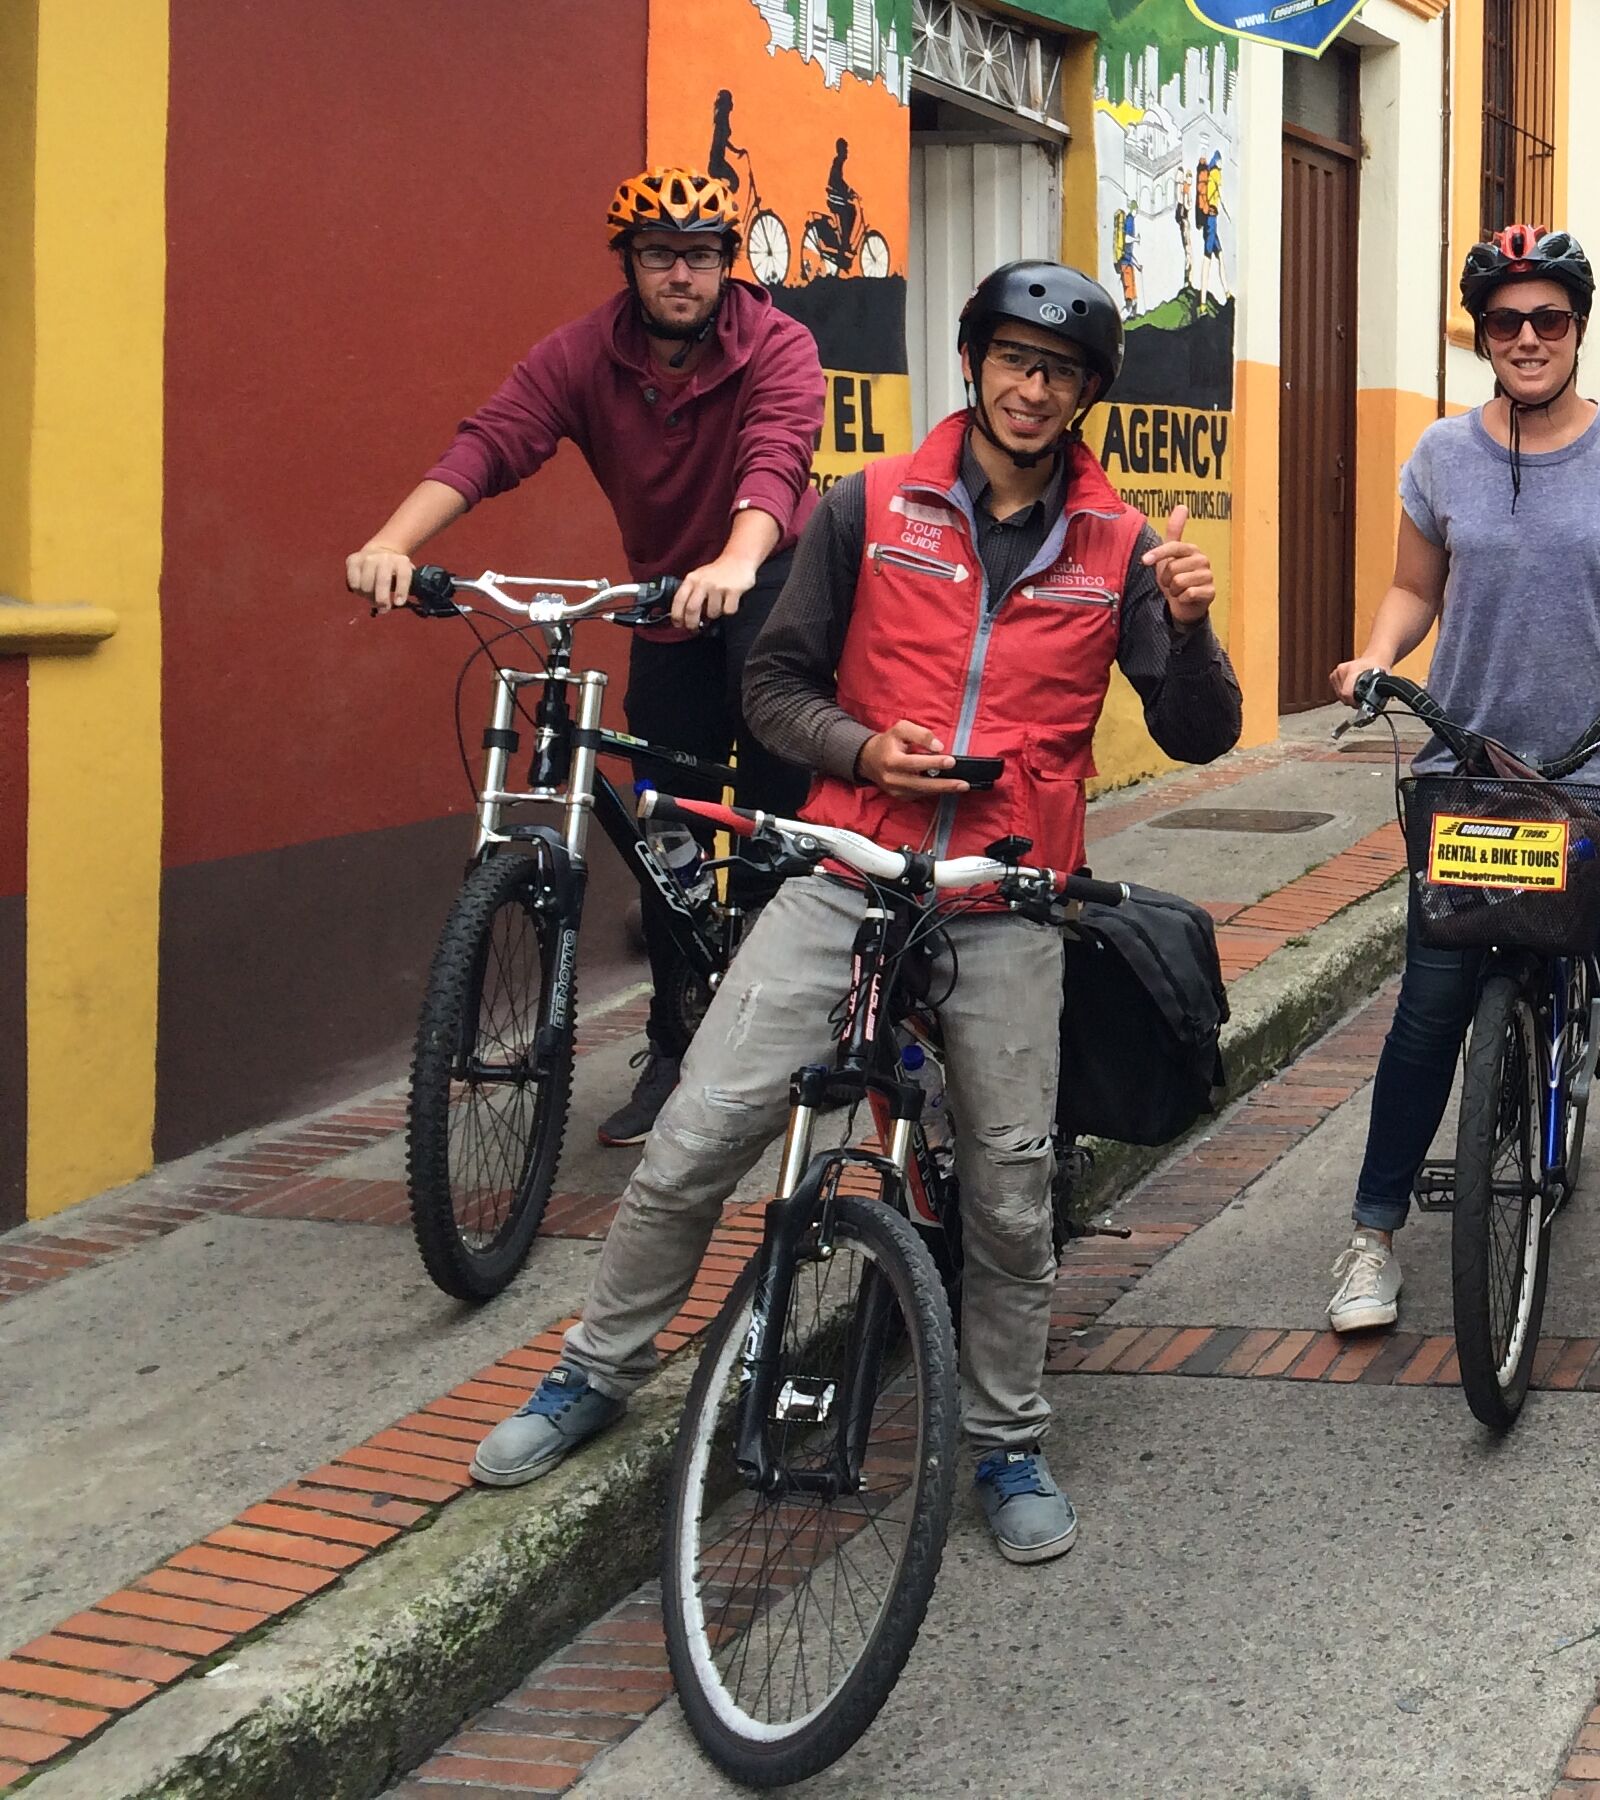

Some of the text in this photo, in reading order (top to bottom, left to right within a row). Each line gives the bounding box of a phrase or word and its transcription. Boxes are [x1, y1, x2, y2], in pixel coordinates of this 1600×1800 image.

[1101, 405, 1228, 480] AGENCY
[904, 519, 943, 540] TOUR
[901, 530, 942, 554] GUIDE
[1460, 824, 1549, 839] BOGOTRAVEL TOURS
[1437, 843, 1560, 868] RENTAL & BIKE TOURS
[1439, 869, 1555, 886] www.bogotraveltours.com
